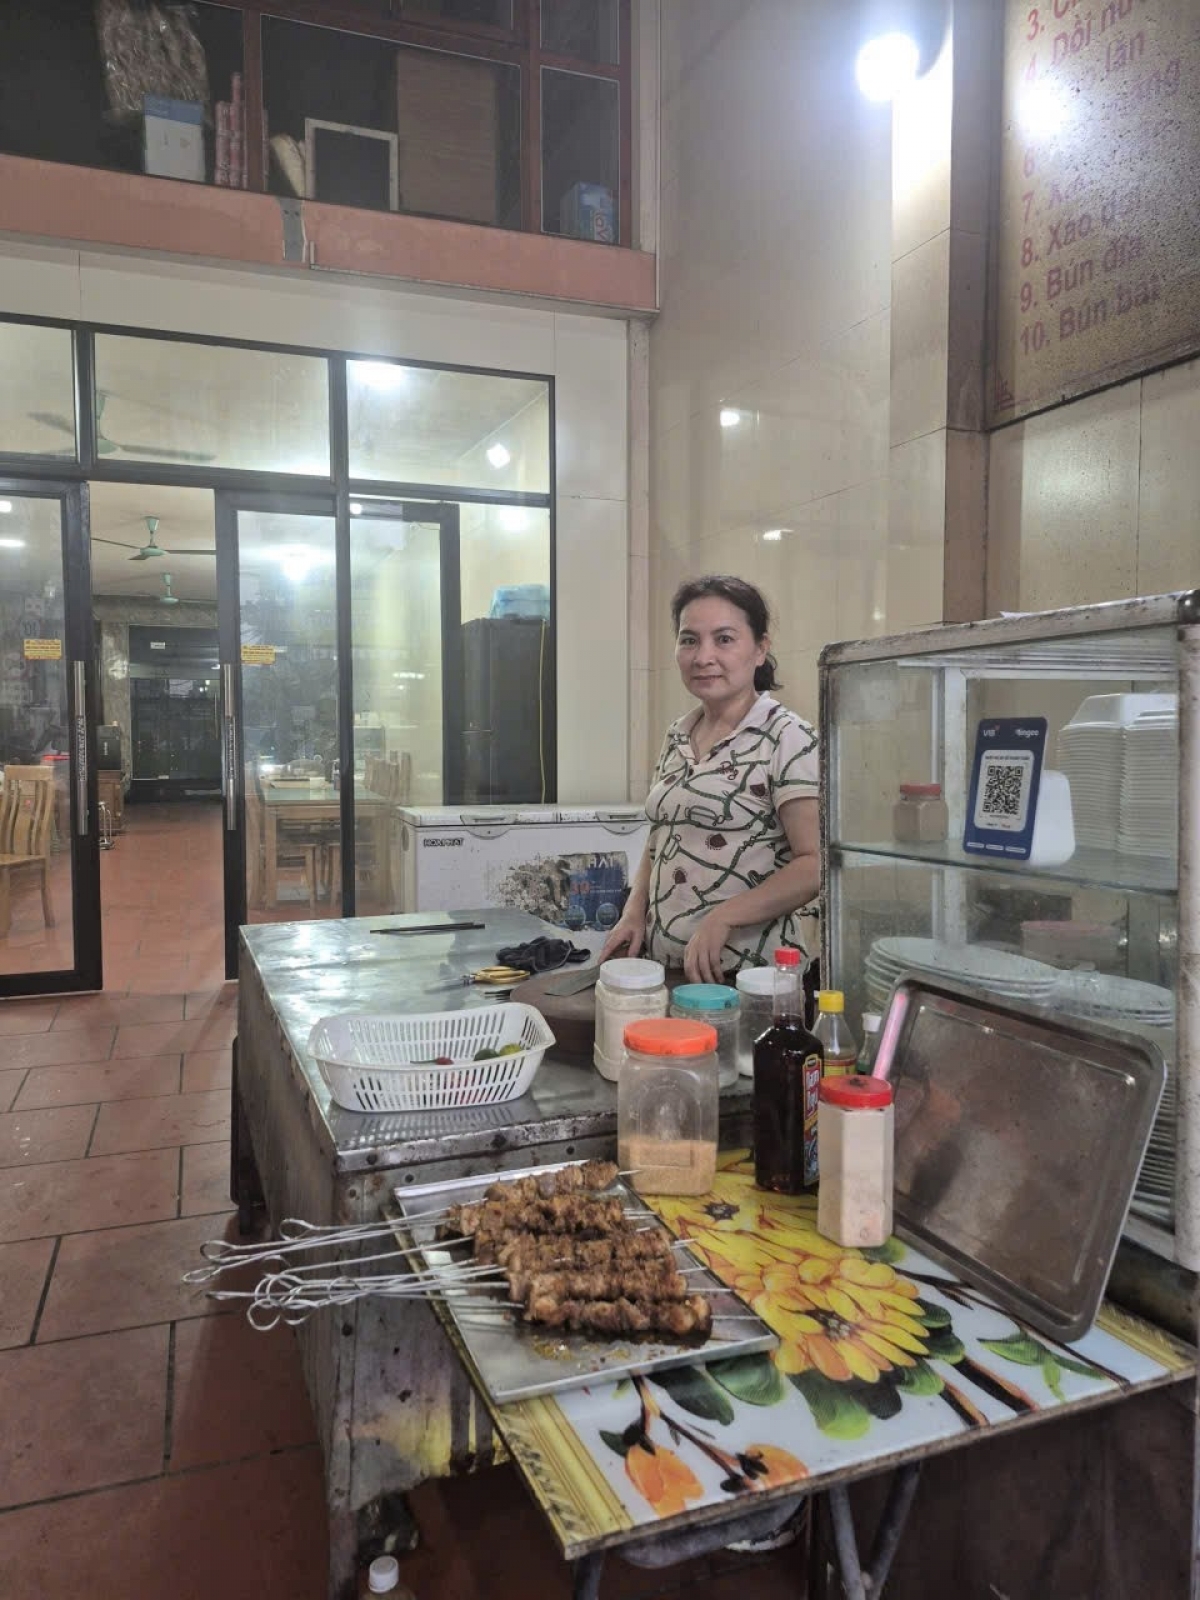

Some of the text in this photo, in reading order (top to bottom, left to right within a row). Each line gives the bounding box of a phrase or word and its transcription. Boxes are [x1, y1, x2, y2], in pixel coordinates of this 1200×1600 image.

[1027, 9, 1045, 41] 3.
[1021, 237, 1040, 268] 8.
[1020, 282, 1039, 313] 9.
[1046, 257, 1094, 301] Bún
[1020, 320, 1051, 356] 10.
[1060, 298, 1107, 342] Bún
